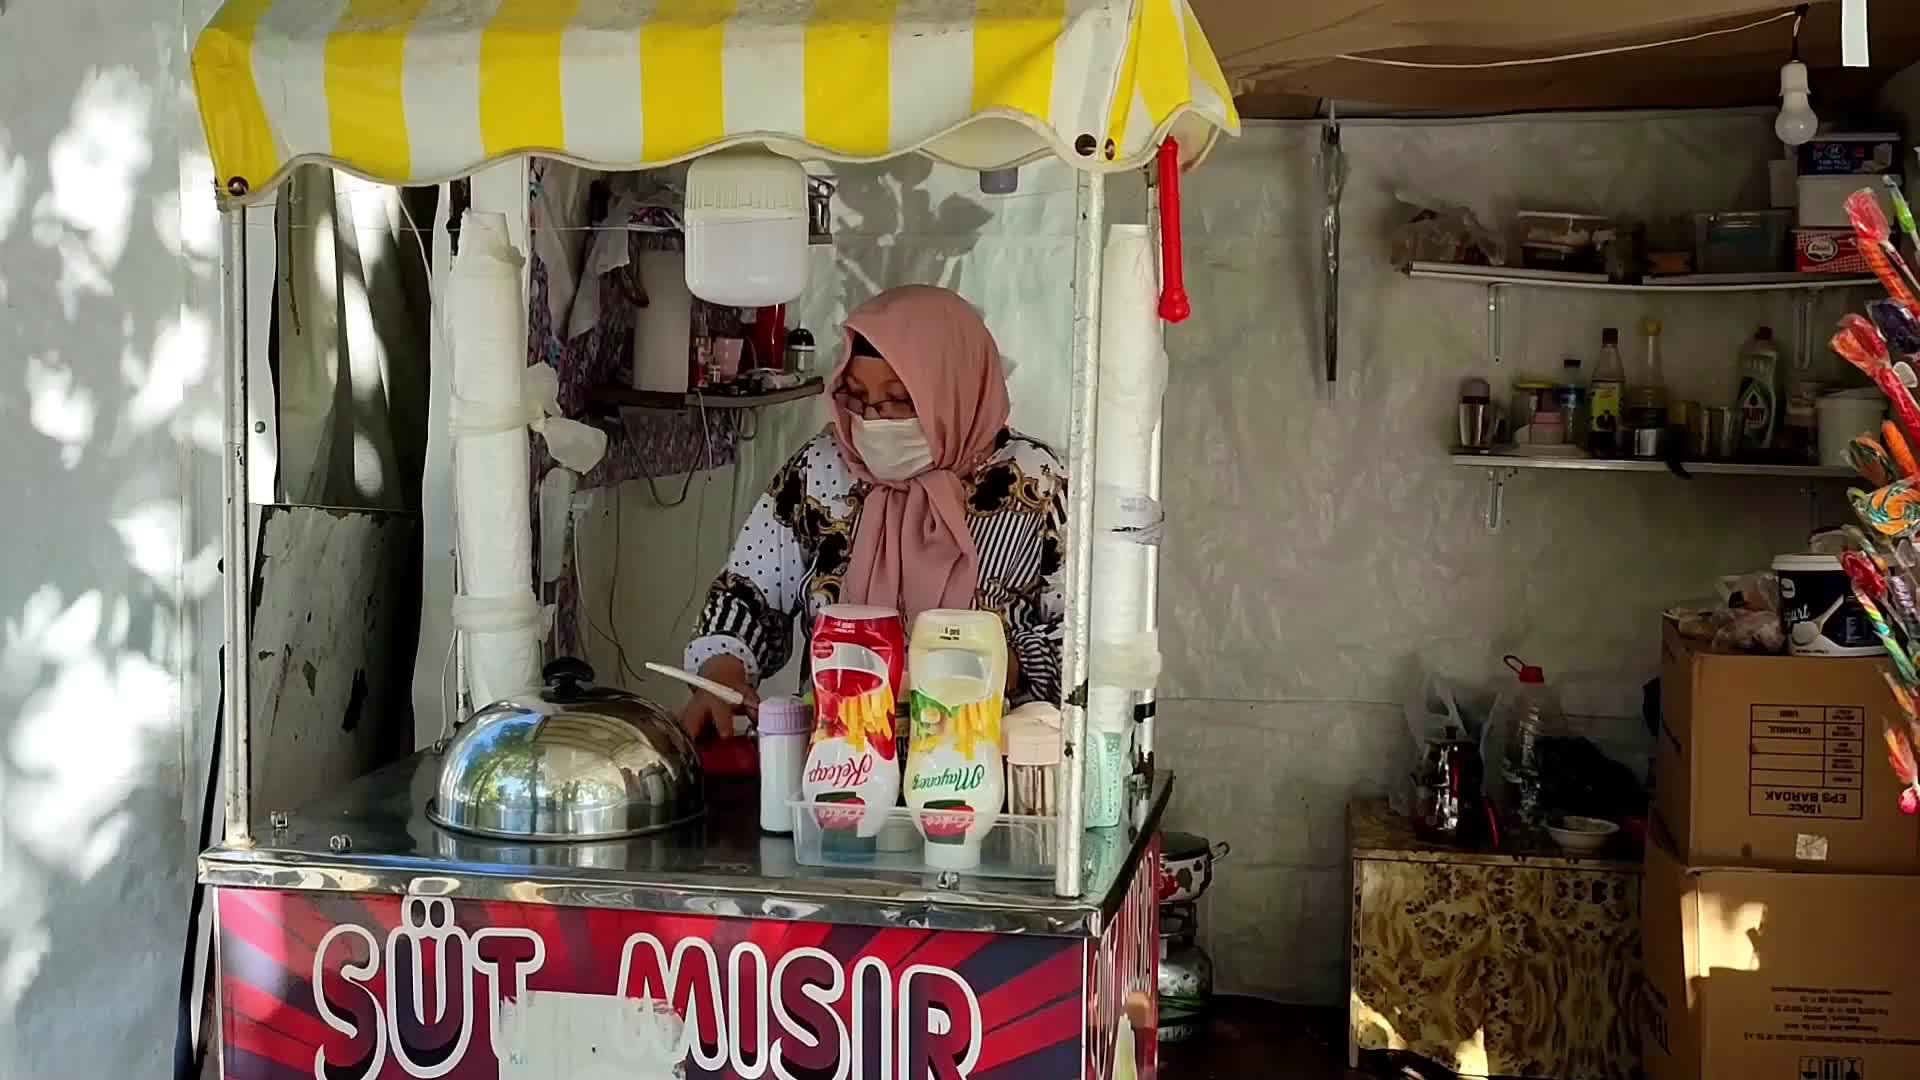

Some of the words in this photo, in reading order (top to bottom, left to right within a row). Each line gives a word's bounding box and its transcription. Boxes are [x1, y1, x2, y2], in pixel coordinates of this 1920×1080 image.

[912, 764, 985, 792] Mayonez
[1764, 791, 1819, 803] BARDAK
[1822, 792, 1848, 804] EPS
[1788, 803, 1822, 814] 150cc
[312, 893, 545, 1080] SÜT
[616, 932, 982, 1080] MISIR
